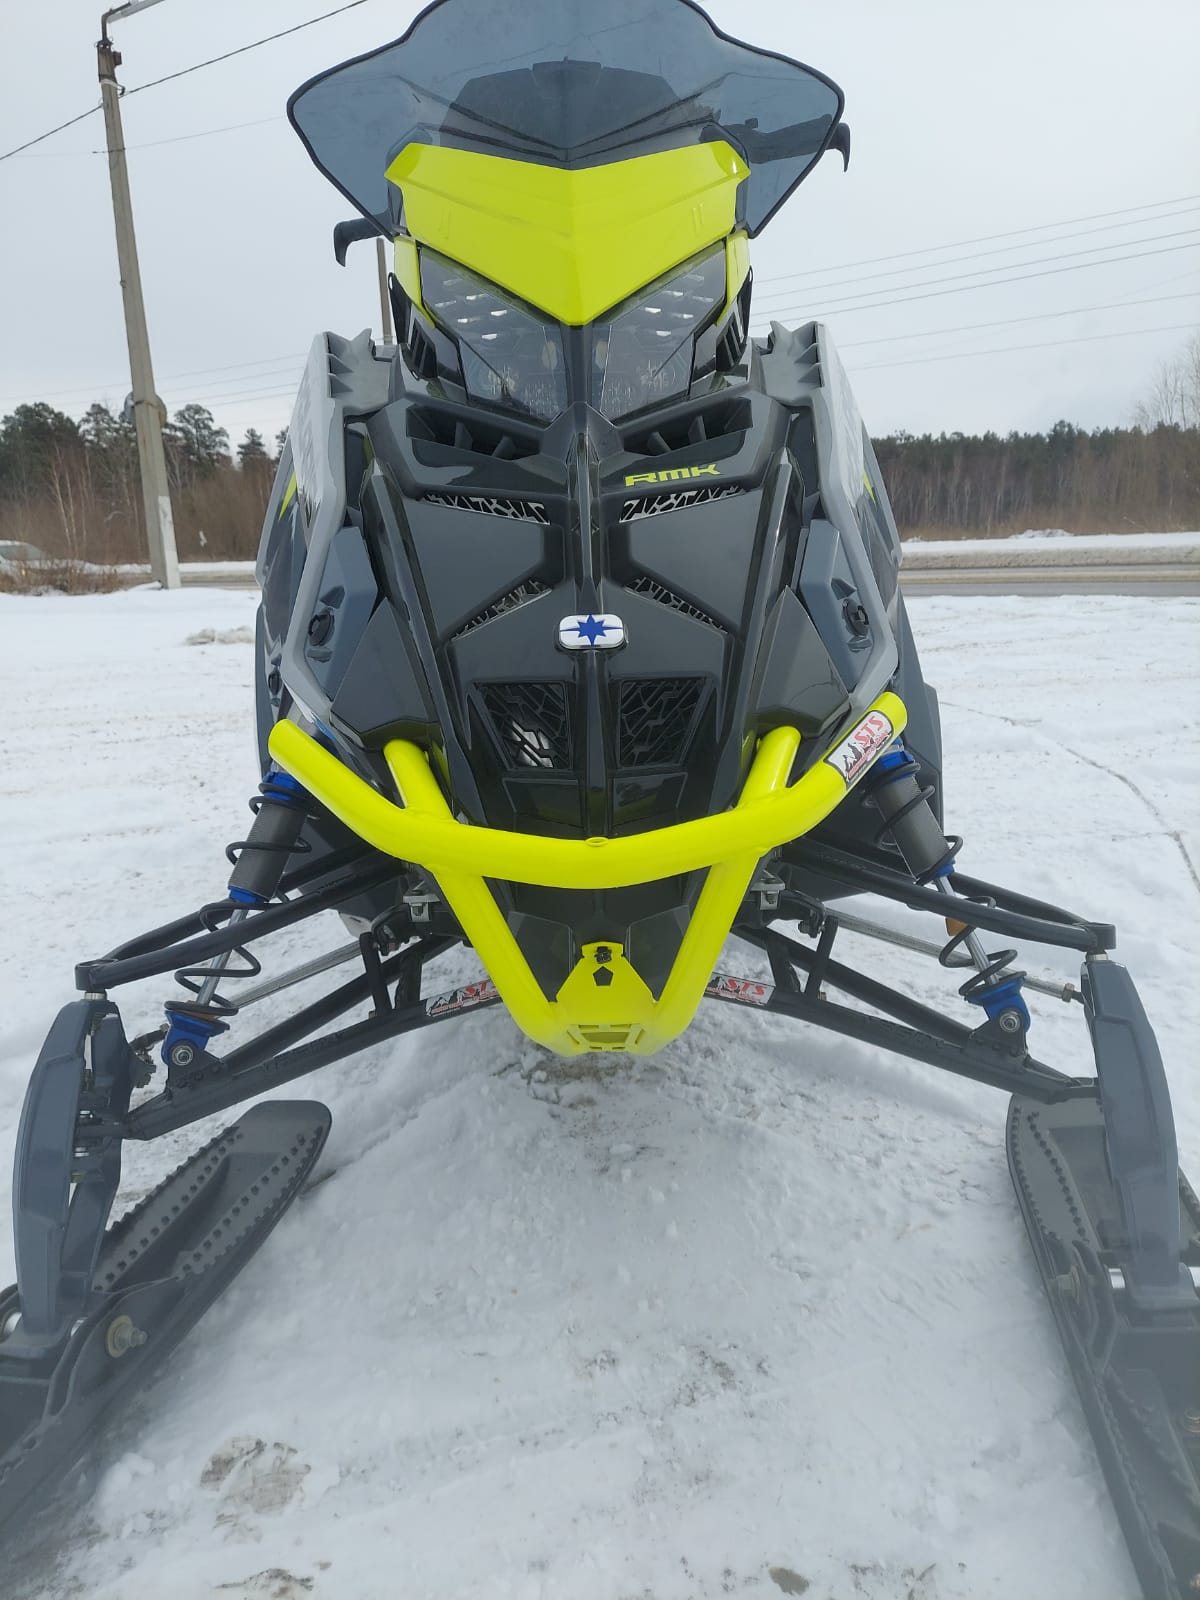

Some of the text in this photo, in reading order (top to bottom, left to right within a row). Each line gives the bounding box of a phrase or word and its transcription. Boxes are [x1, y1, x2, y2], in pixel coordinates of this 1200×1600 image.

[624, 463, 720, 487] RMK
[854, 716, 884, 748] STS
[726, 978, 767, 996] STS
